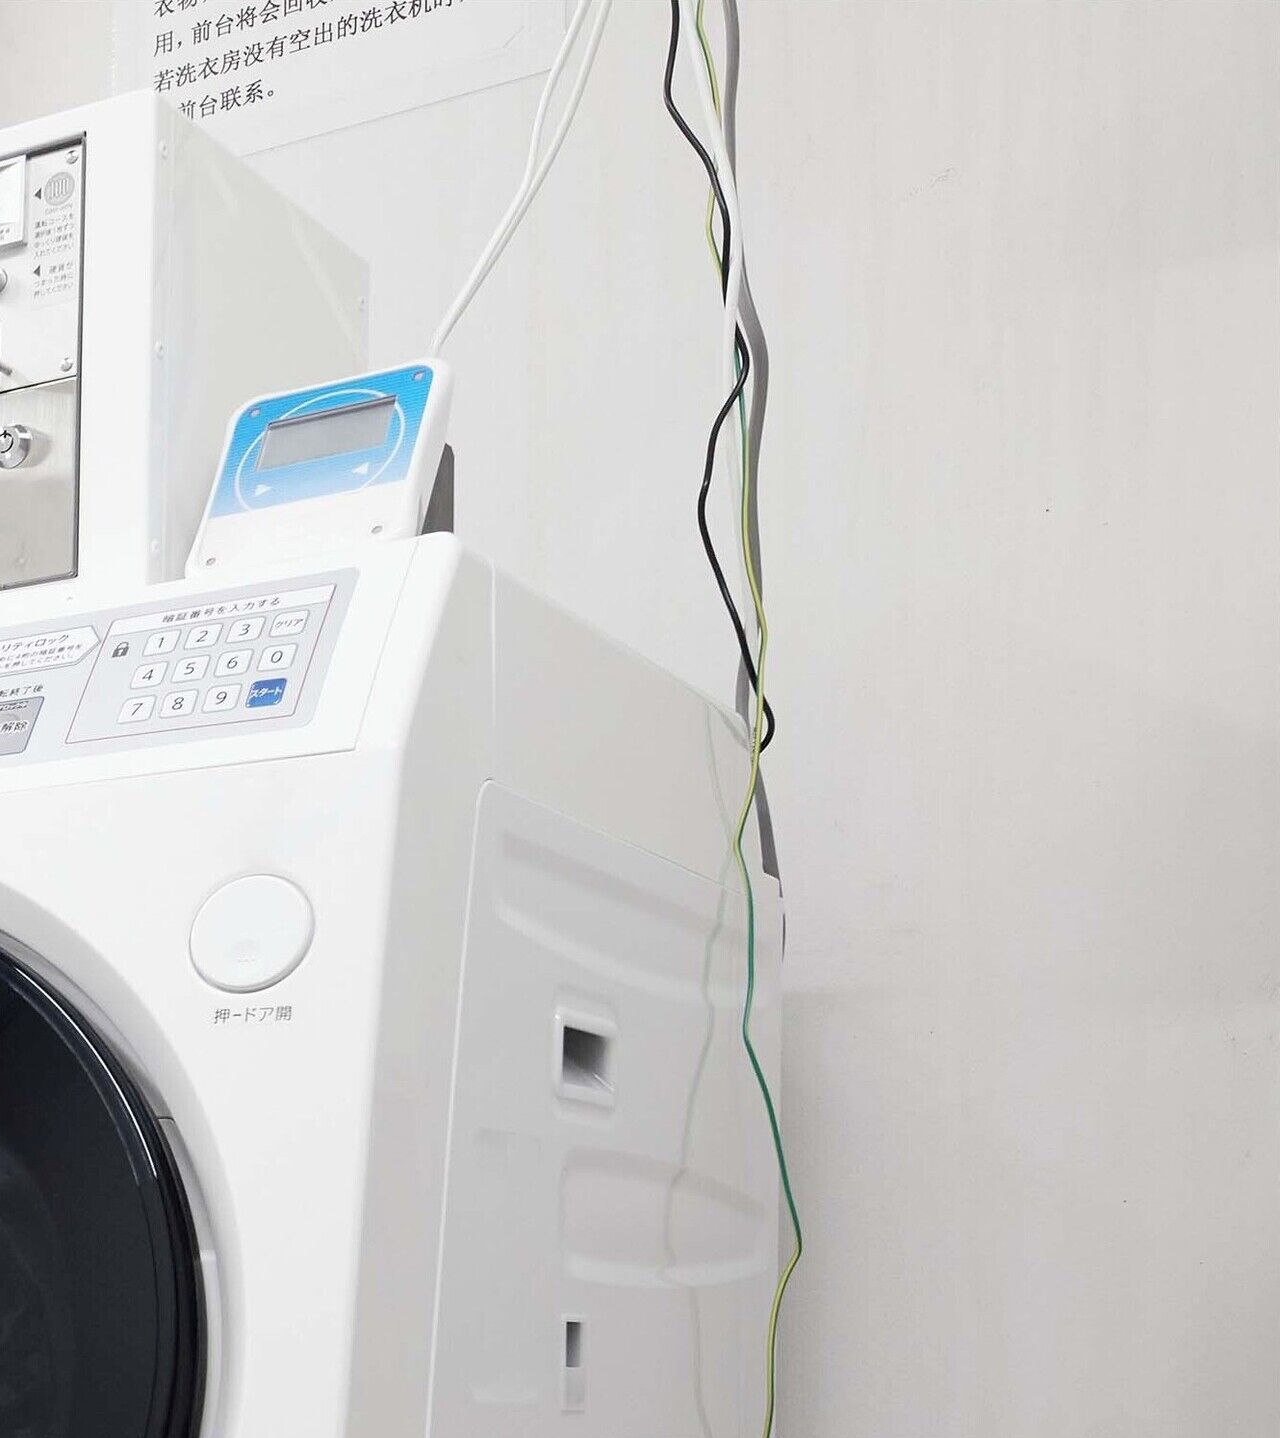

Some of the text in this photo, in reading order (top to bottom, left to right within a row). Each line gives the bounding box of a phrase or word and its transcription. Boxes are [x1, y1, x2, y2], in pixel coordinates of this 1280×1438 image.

[162, 597, 281, 624] 暗証番号を入力する
[195, 629, 209, 643] 2
[239, 623, 251, 636] 3
[157, 636, 165, 649] 1
[226, 655, 238, 669] 6
[270, 650, 283, 664] 0
[142, 668, 154, 682] 4
[183, 662, 195, 676] 5
[171, 696, 185, 711] 8
[215, 691, 228, 706] 9
[132, 702, 143, 717] 7
